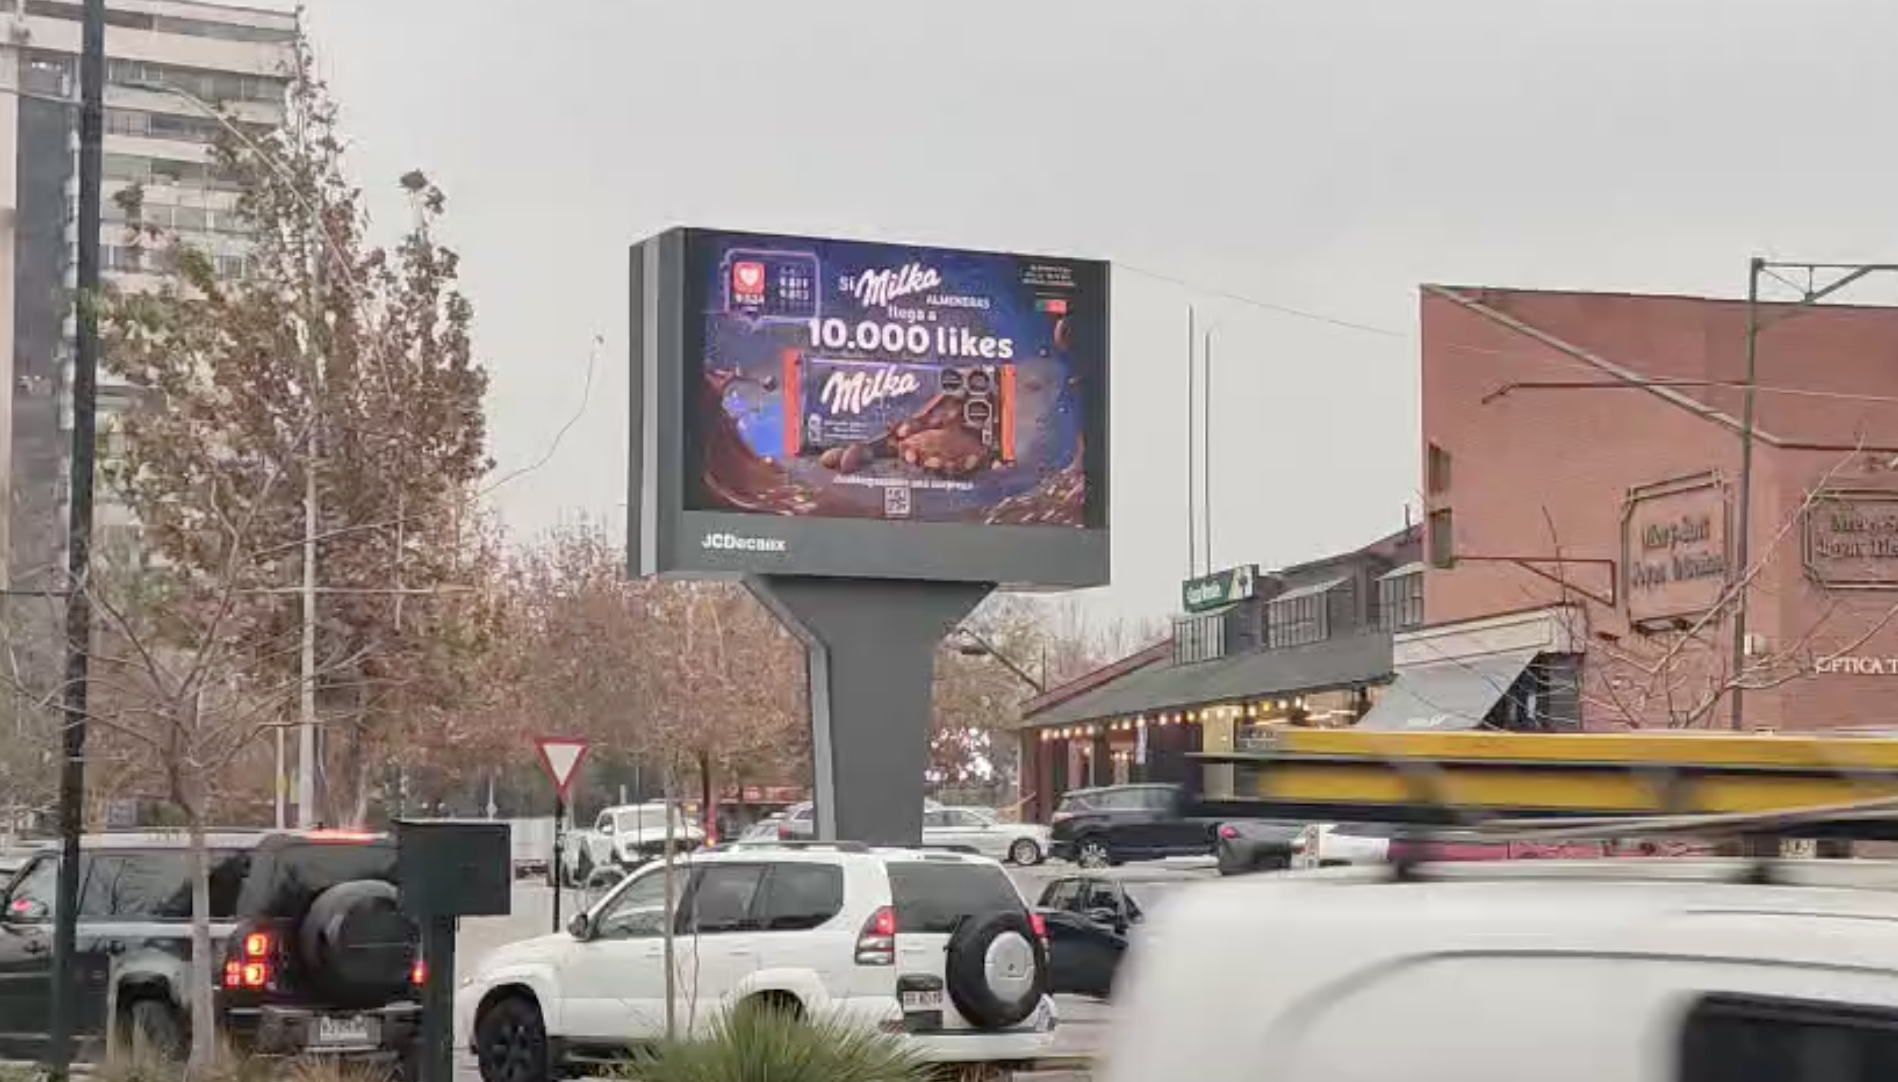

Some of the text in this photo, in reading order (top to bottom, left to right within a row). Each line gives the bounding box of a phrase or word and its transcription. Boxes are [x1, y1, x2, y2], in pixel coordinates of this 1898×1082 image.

[854, 262, 941, 307] Milka
[887, 305, 937, 323] llega a
[808, 317, 1013, 358] 10.000 likes
[820, 365, 920, 414] Milka
[701, 533, 786, 551] JCDecaux
